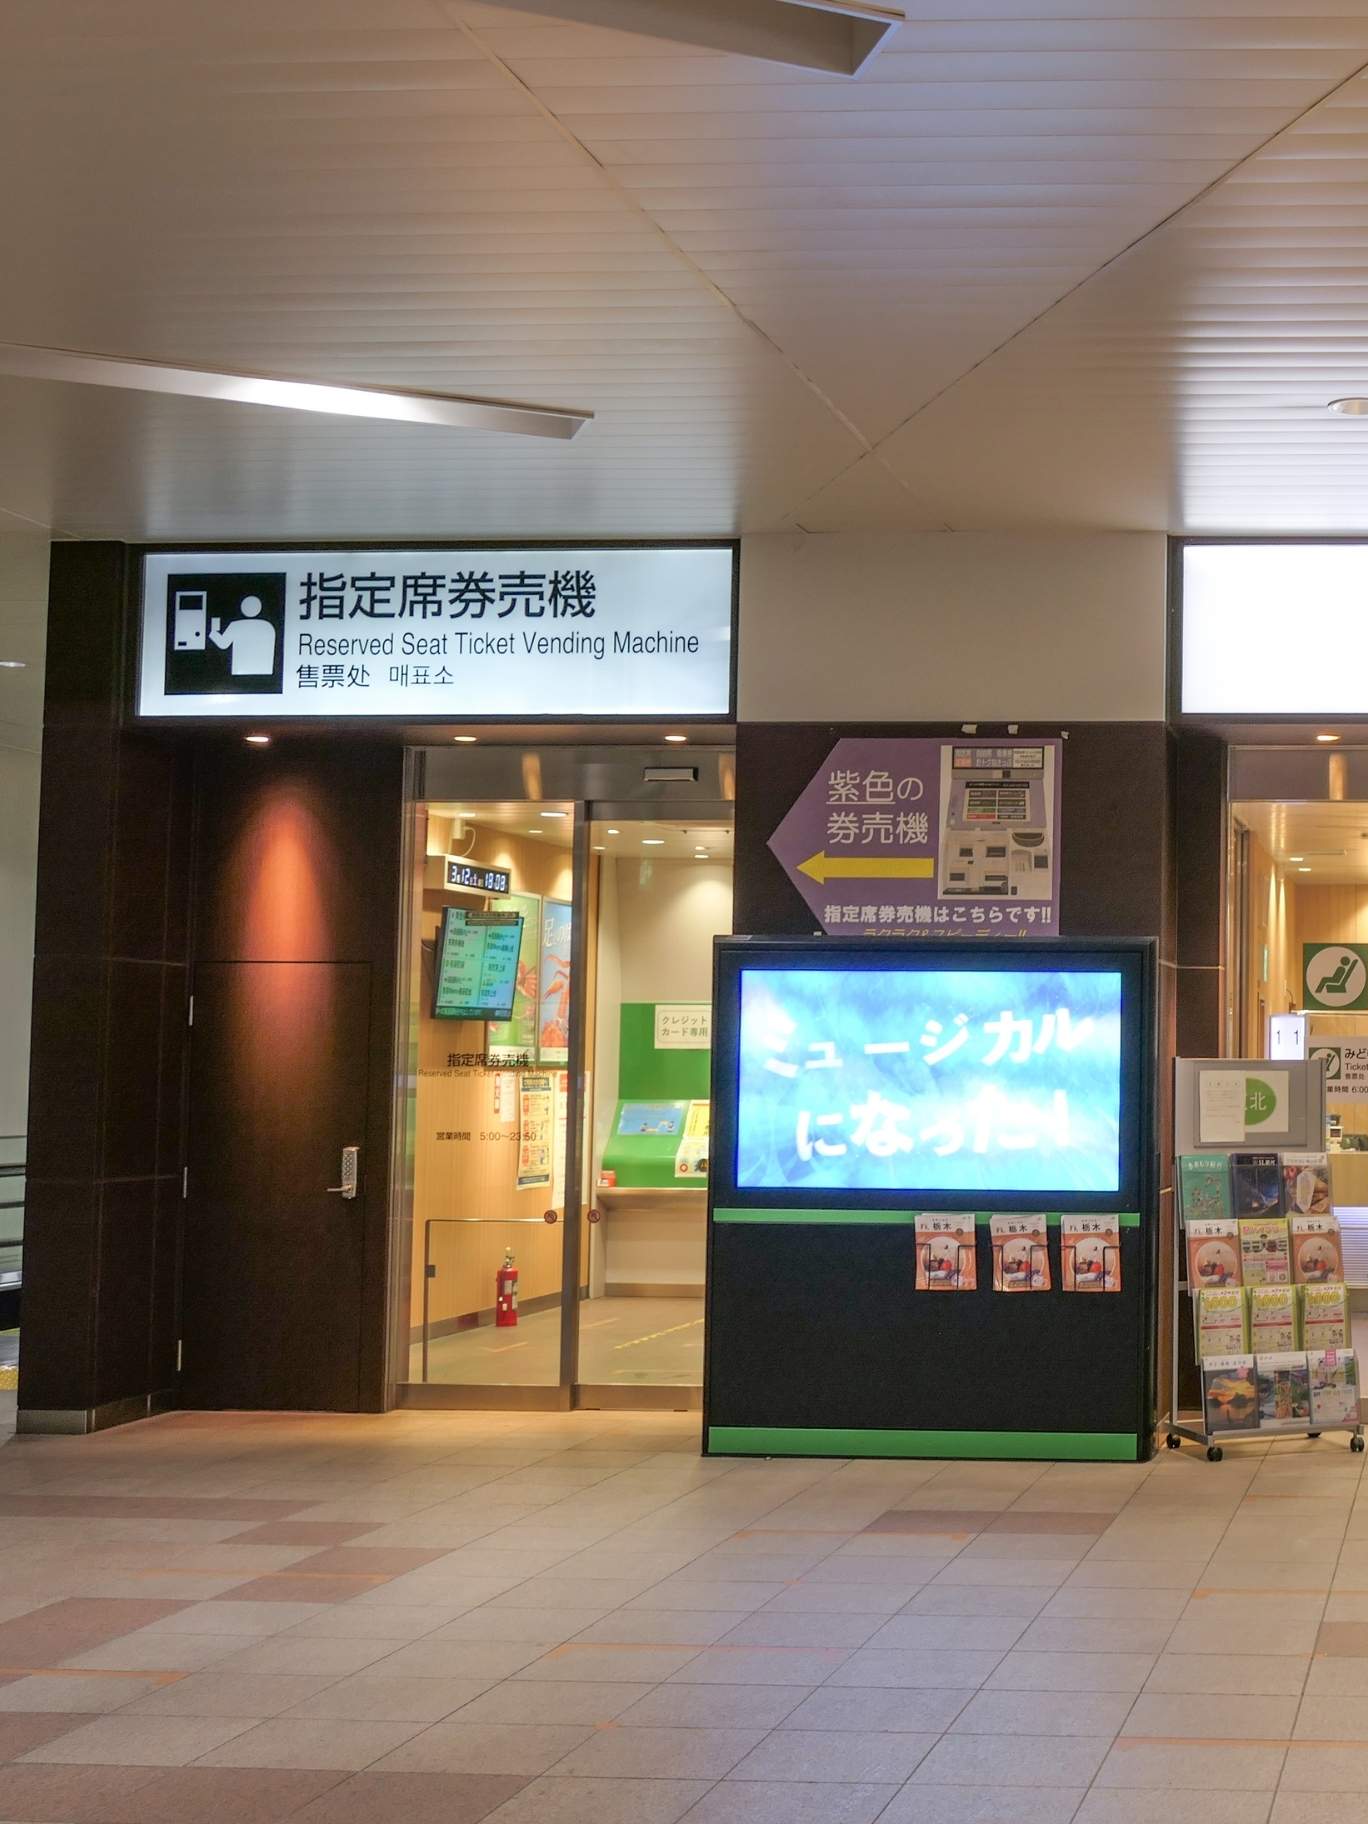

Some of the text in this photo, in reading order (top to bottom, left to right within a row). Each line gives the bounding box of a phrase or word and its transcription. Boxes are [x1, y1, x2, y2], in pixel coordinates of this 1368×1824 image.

[299, 570, 597, 621] 指定席券売機
[298, 629, 700, 660] Reserved Seat Ticket Vending Machine
[295, 664, 371, 689] 售票处
[388, 663, 455, 688] 매표소
[827, 769, 924, 803] 紫色の
[826, 811, 929, 845] 券売機
[661, 1015, 708, 1026] クレジット
[661, 1026, 708, 1038] カード専用
[763, 1006, 1096, 1078] ミュージカル
[447, 1052, 530, 1068] 指定席券売機
[1344, 1062, 1368, 1072] Ticket
[418, 1069, 452, 1078] Reserved
[454, 1069, 471, 1078] Seat
[1326, 1085, 1349, 1094] 業時間
[435, 1131, 471, 1142] 営業時間
